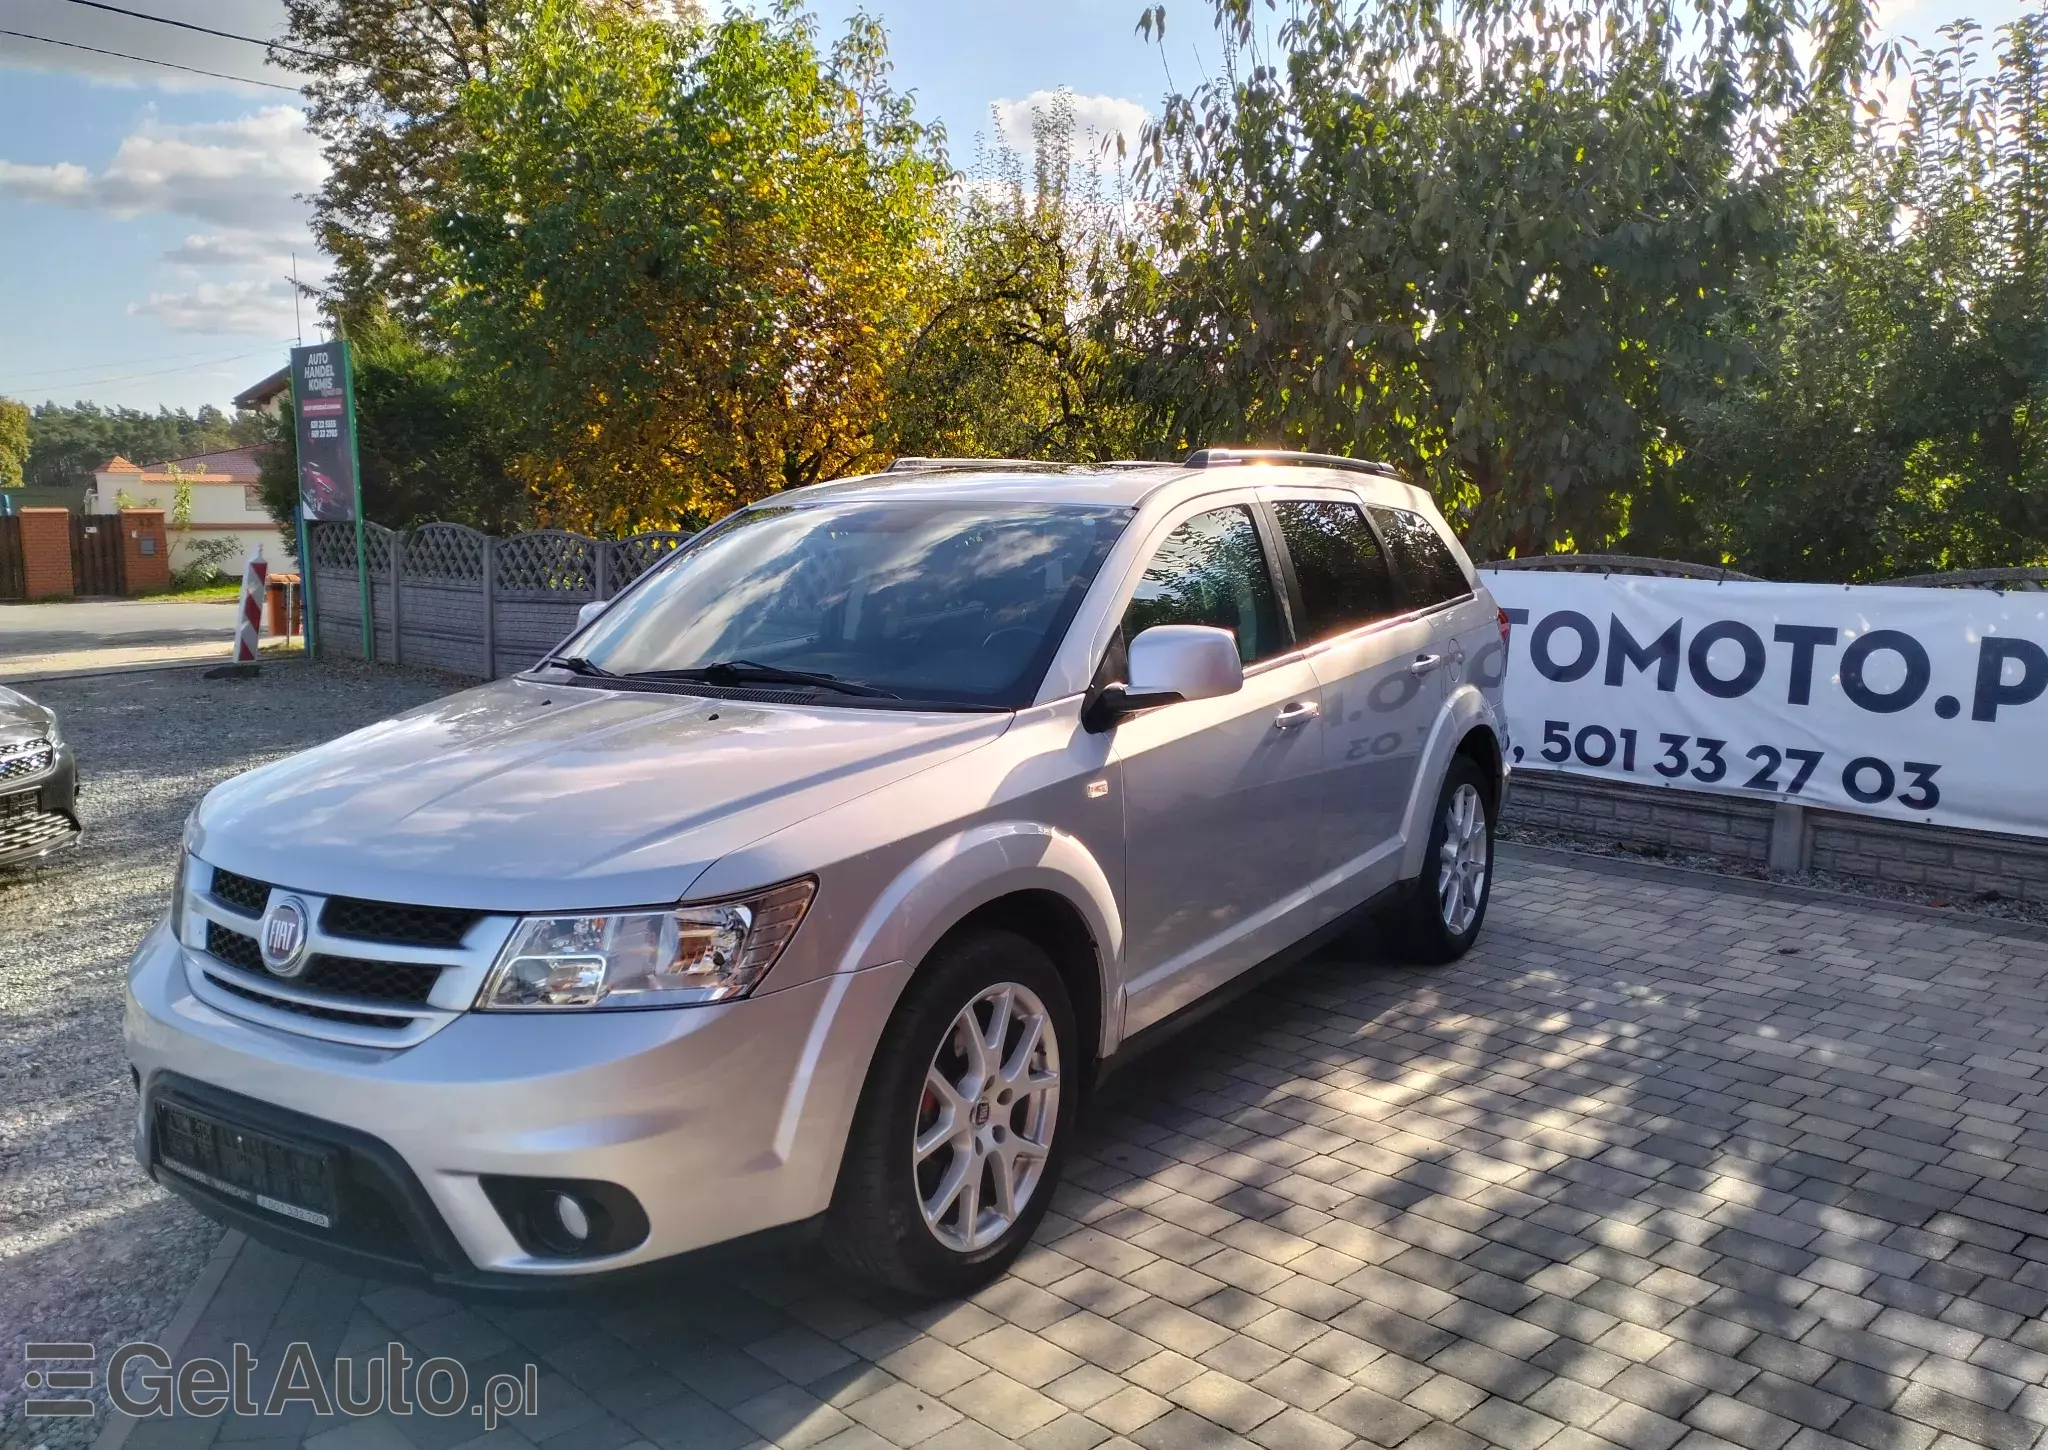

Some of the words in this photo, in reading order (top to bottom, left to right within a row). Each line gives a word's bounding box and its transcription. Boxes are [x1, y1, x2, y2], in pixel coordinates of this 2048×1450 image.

[308, 352, 328, 365] AUTO
[304, 364, 335, 378] HANDEL
[308, 377, 333, 391] KOMIS
[1541, 720, 1637, 772] 501
[1653, 733, 1729, 784] 33
[1743, 745, 1825, 795] 27
[1842, 756, 1942, 811] 03
[269, 919, 296, 954] FIAT
